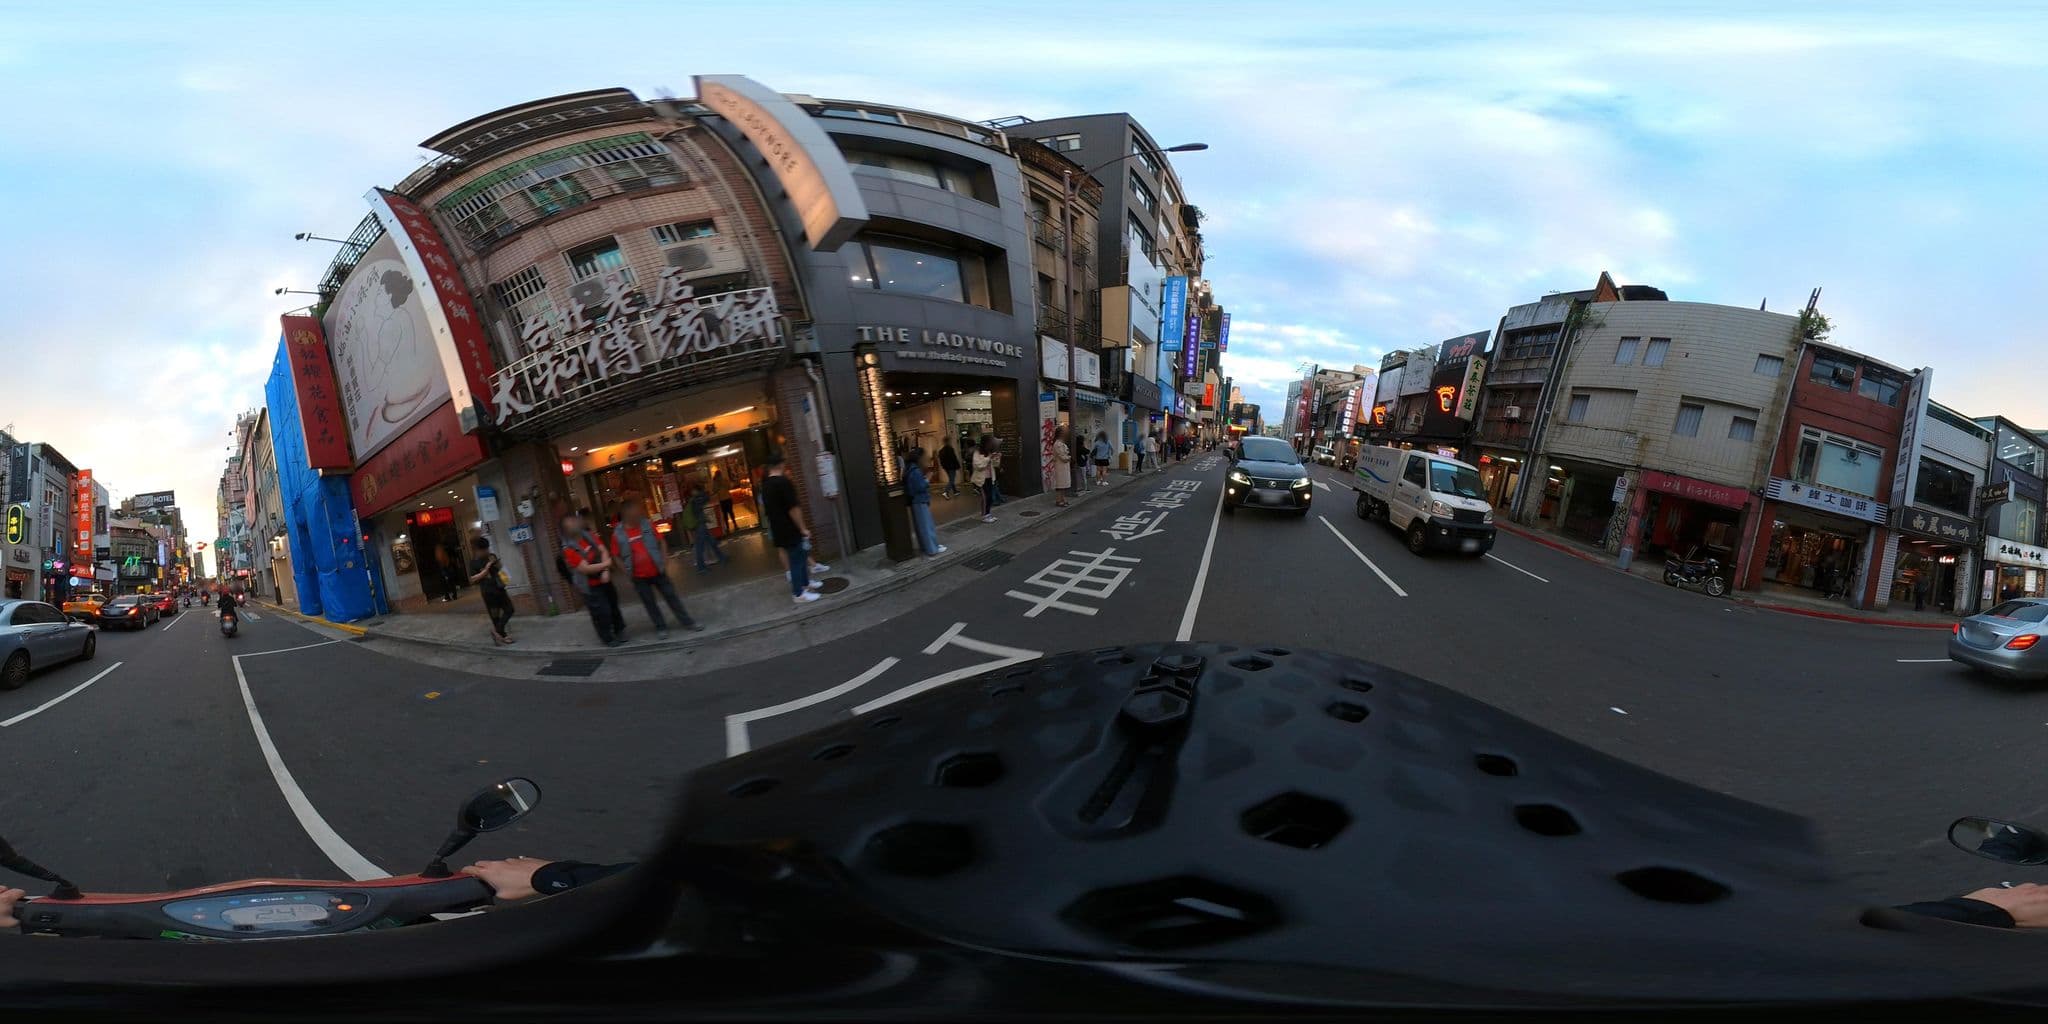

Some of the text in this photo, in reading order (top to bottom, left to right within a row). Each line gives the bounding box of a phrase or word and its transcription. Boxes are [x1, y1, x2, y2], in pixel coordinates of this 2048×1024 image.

[521, 265, 696, 352] 台北老店
[491, 292, 784, 426] 太和傳統餅
[856, 325, 1023, 359] THE LADYWORE
[153, 494, 174, 504] HOTEL
